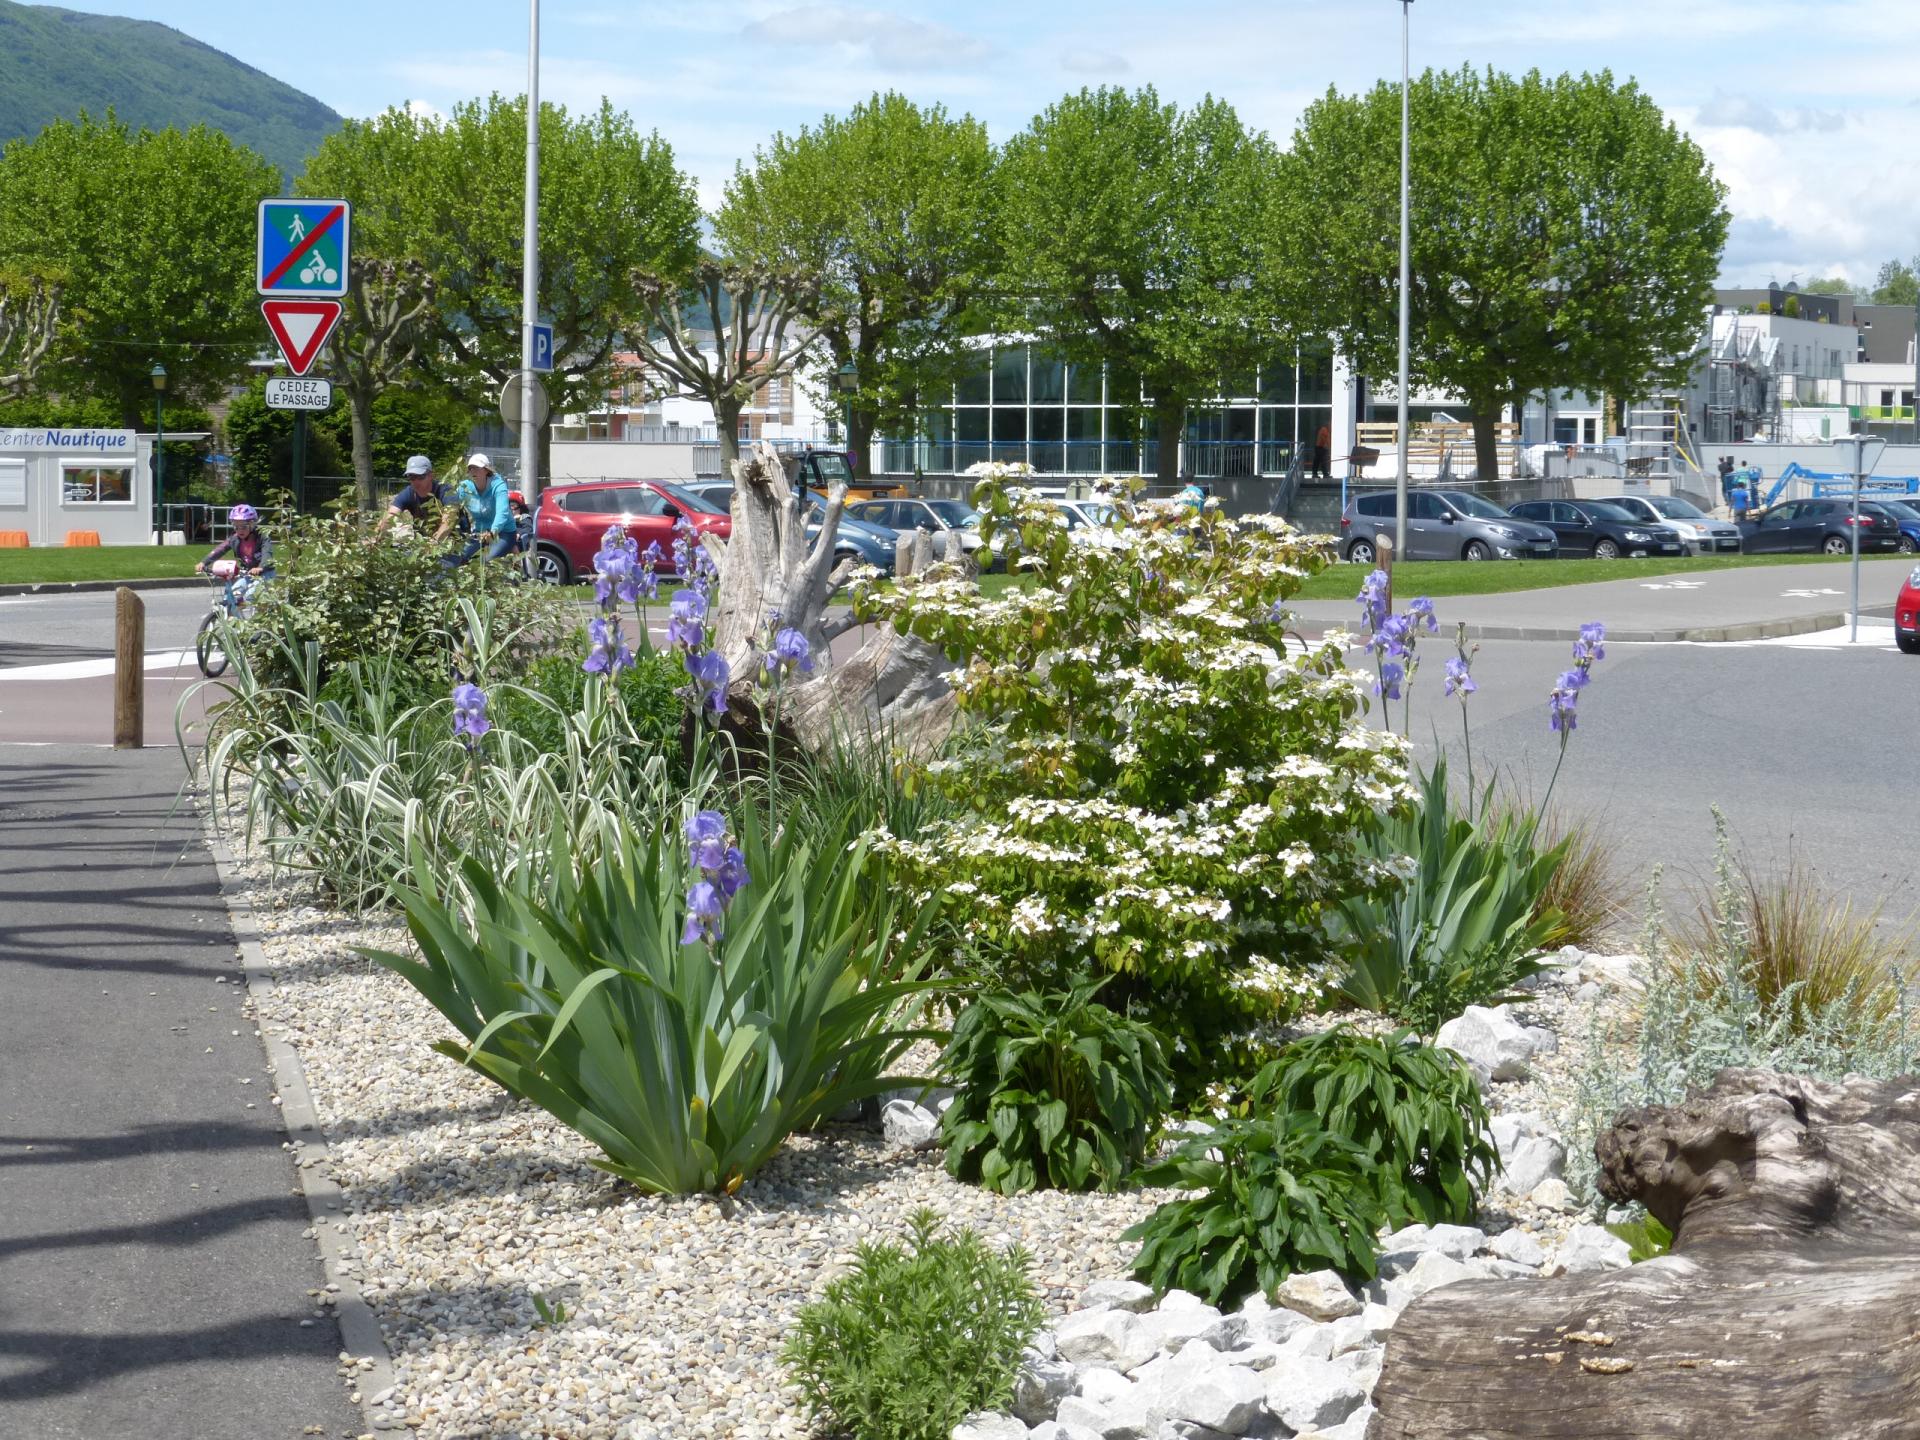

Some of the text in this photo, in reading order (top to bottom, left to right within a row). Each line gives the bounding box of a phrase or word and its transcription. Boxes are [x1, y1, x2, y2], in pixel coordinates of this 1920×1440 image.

[537, 333, 547, 362] P
[279, 381, 317, 393] CEDEZ
[268, 393, 328, 406] LE PASSAGE
